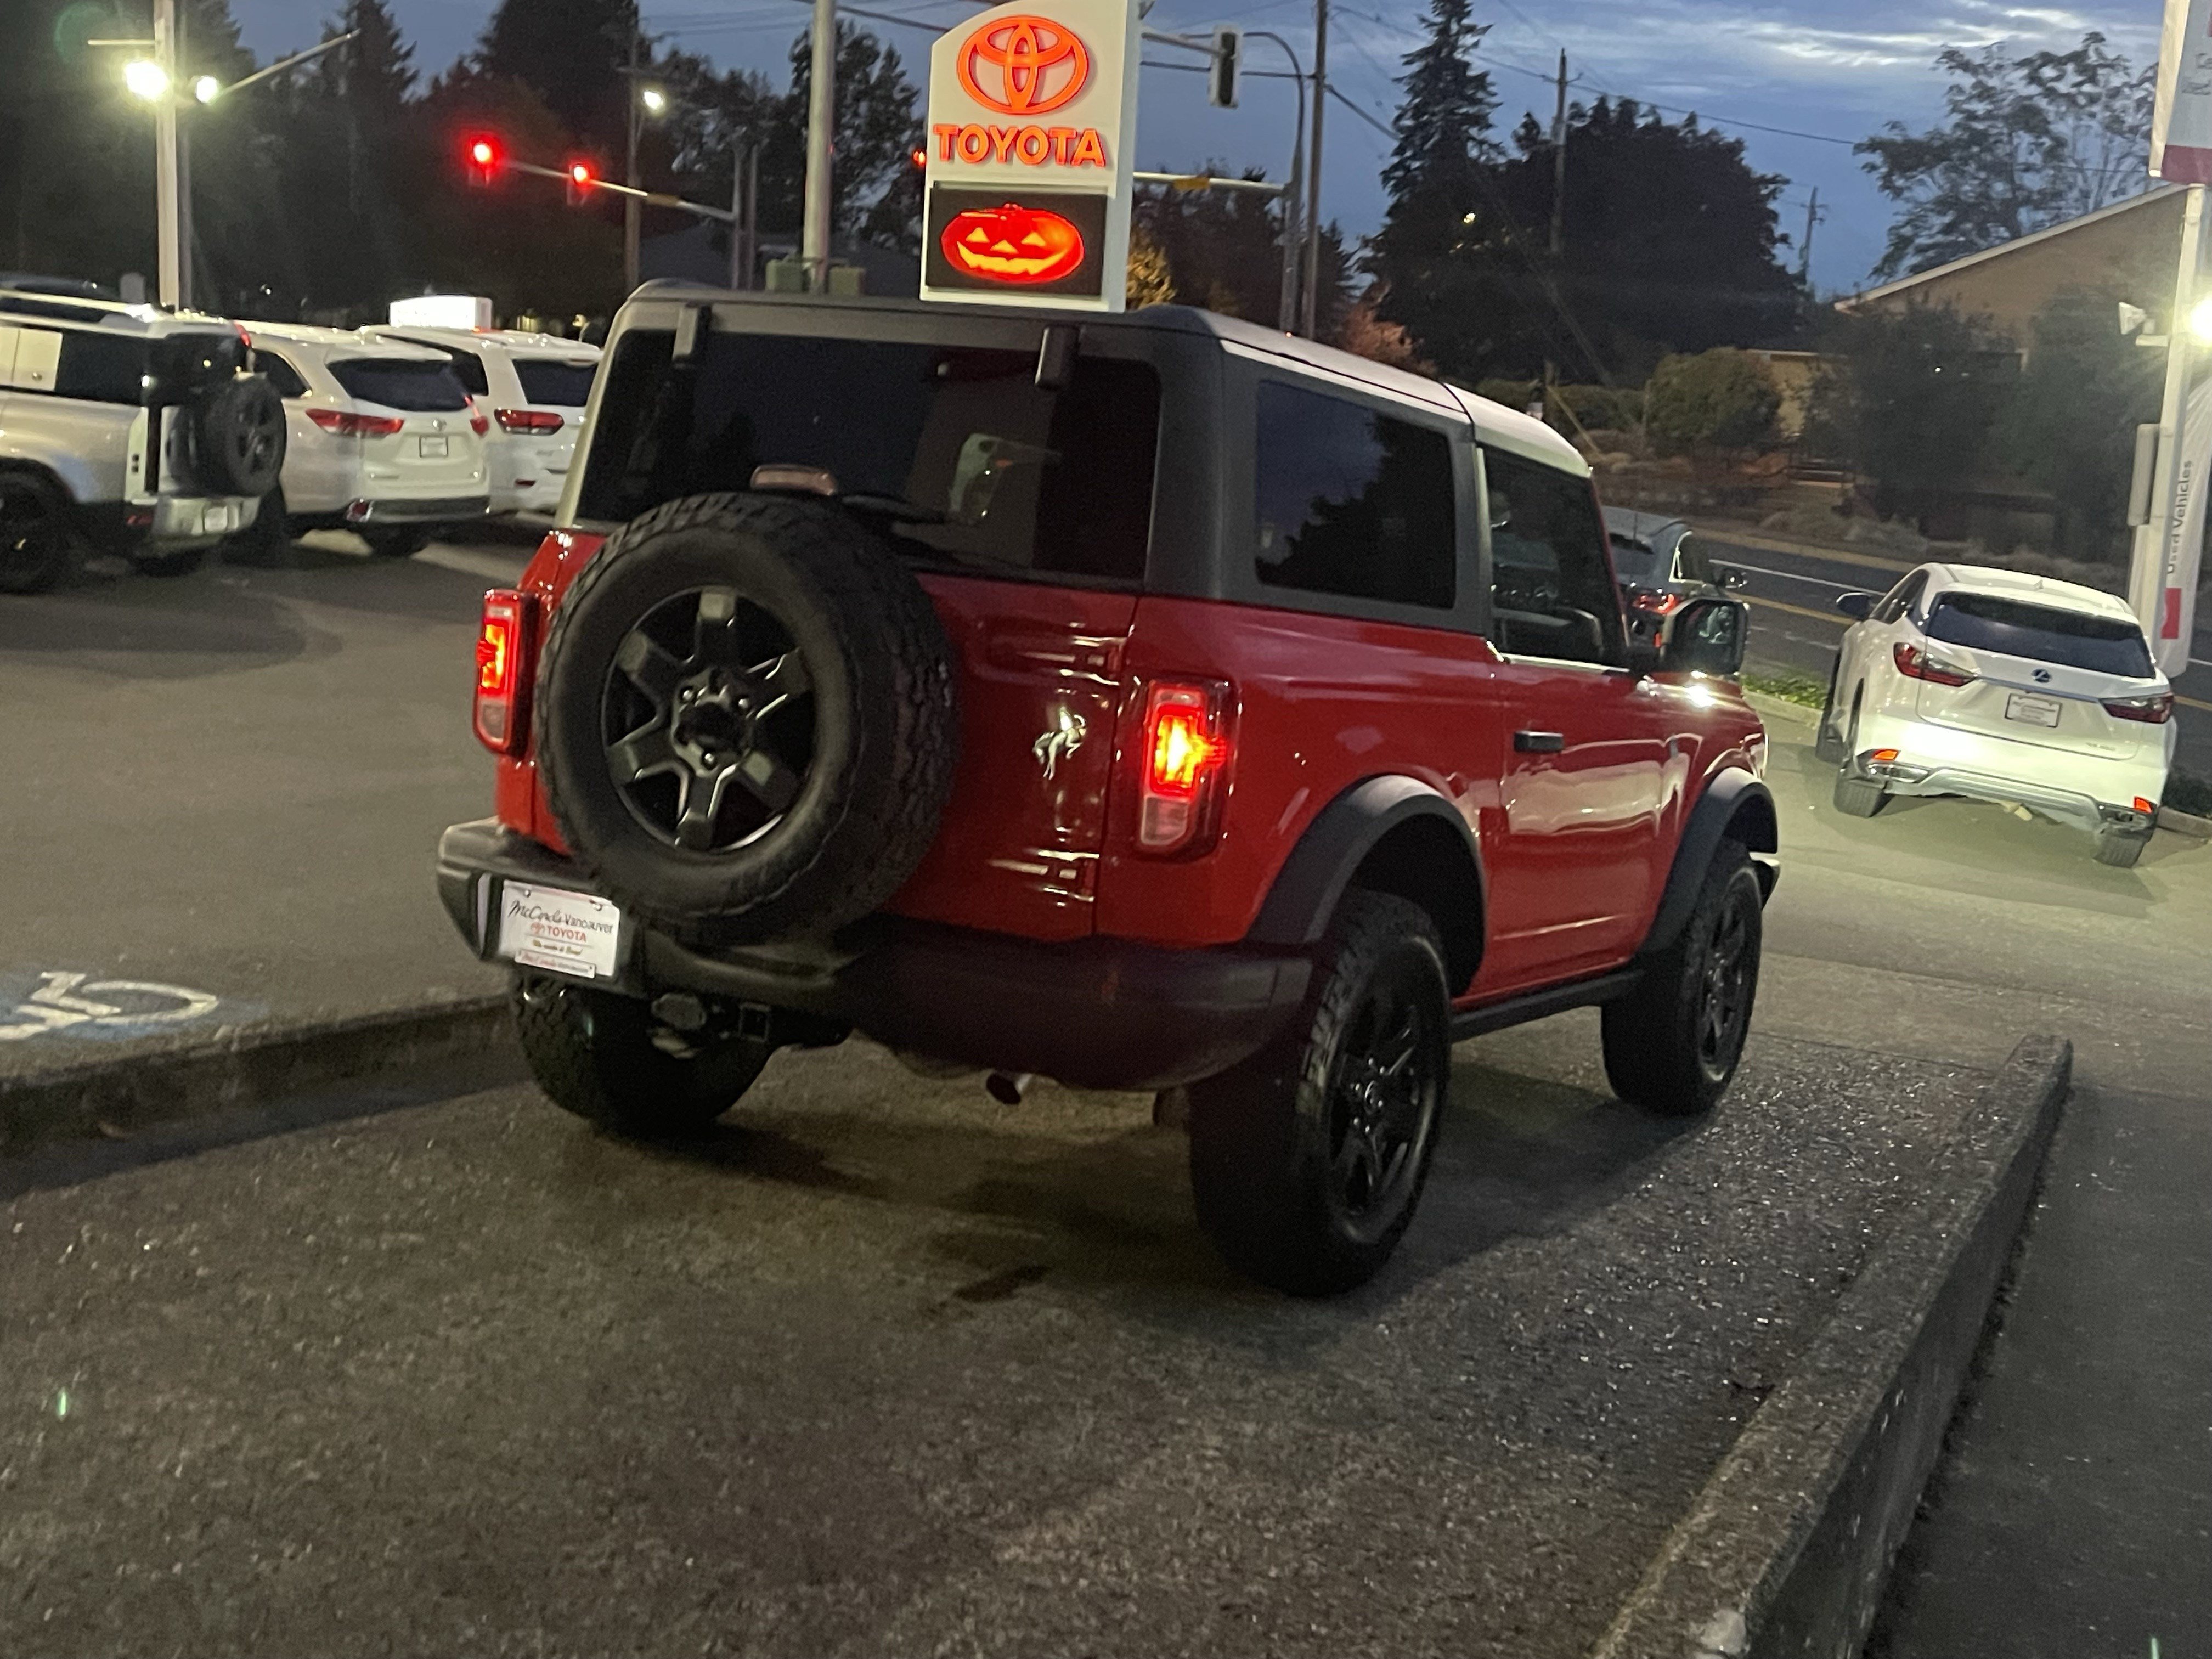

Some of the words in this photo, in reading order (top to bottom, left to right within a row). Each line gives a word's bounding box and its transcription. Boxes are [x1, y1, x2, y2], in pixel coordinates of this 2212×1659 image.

[934, 124, 1106, 167] TOYOTA
[2173, 460, 2192, 528] Vehicles
[548, 925, 586, 943] TOYOTA
